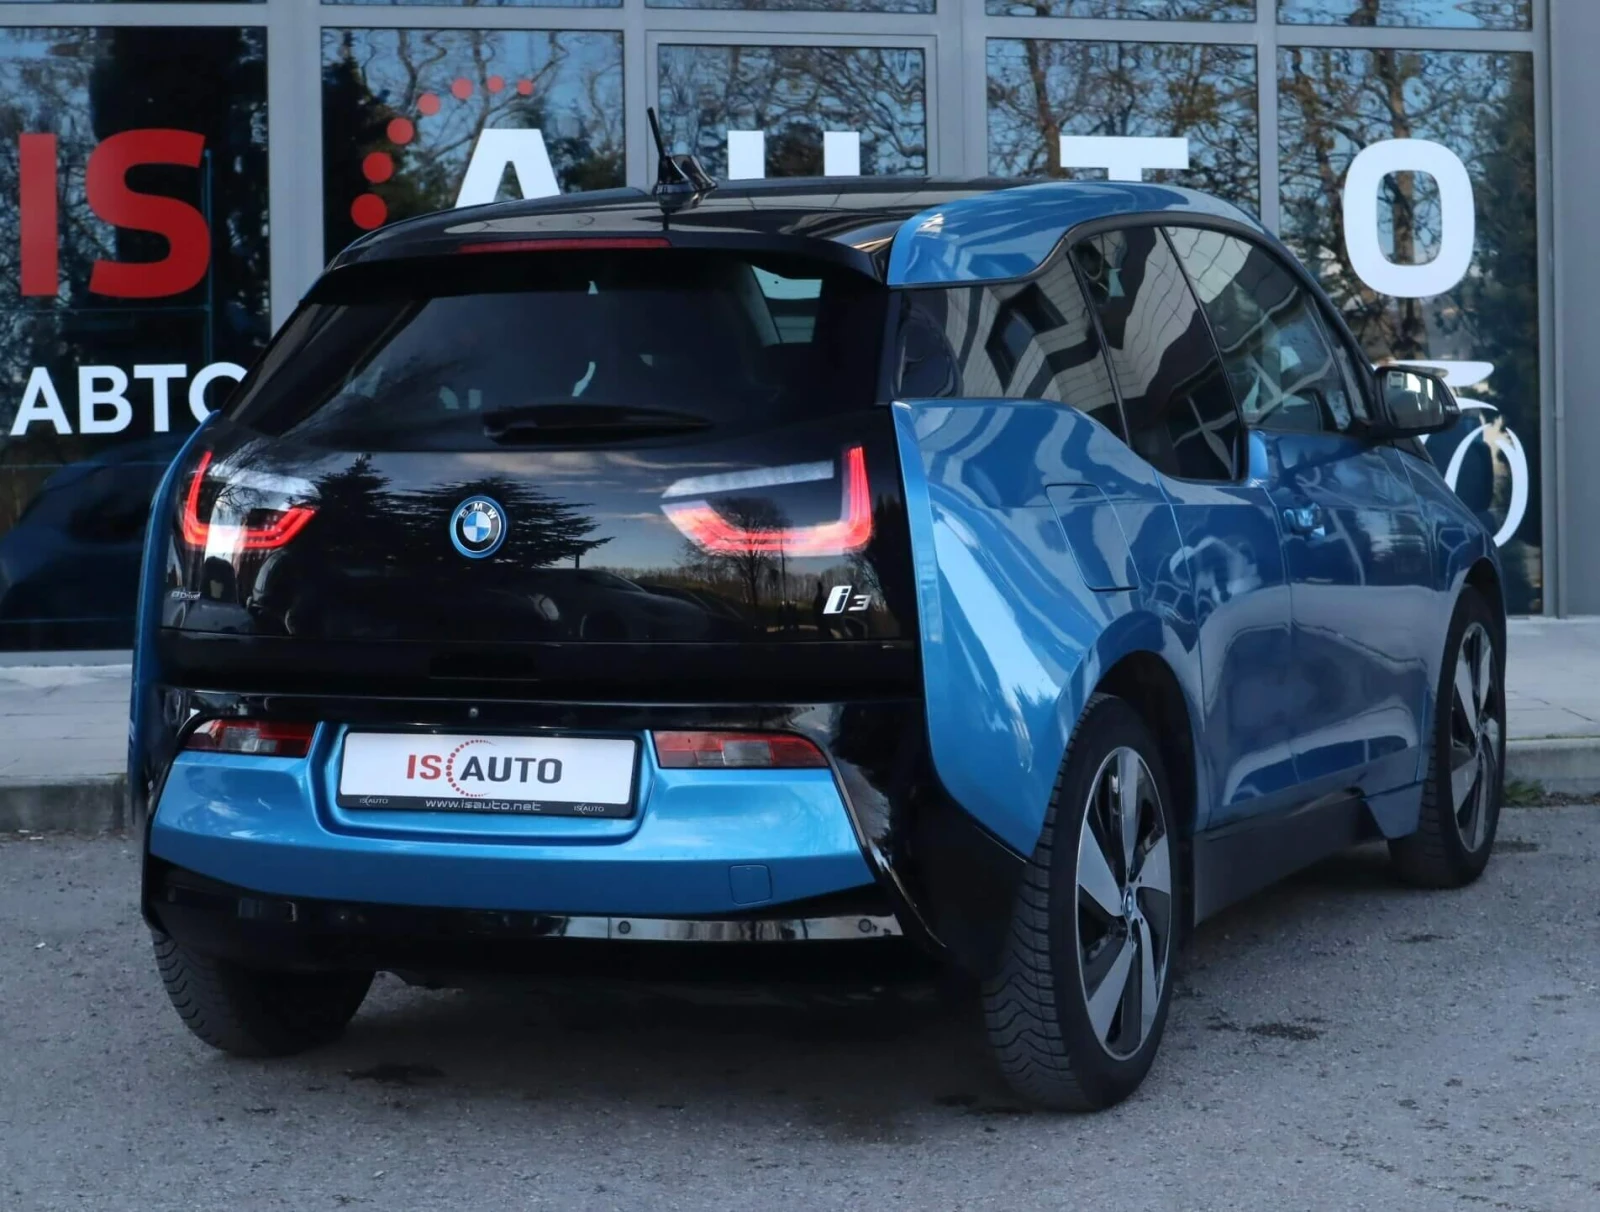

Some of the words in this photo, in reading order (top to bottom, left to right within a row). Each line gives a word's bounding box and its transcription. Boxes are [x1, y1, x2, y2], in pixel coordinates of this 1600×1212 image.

[18, 128, 211, 298] IS
[455, 127, 1476, 298] ATO
[460, 502, 498, 520] BMW
[823, 585, 872, 614] i3
[406, 754, 442, 780] IS
[459, 756, 563, 784] AUTO
[425, 799, 541, 812] www.isauto.net
